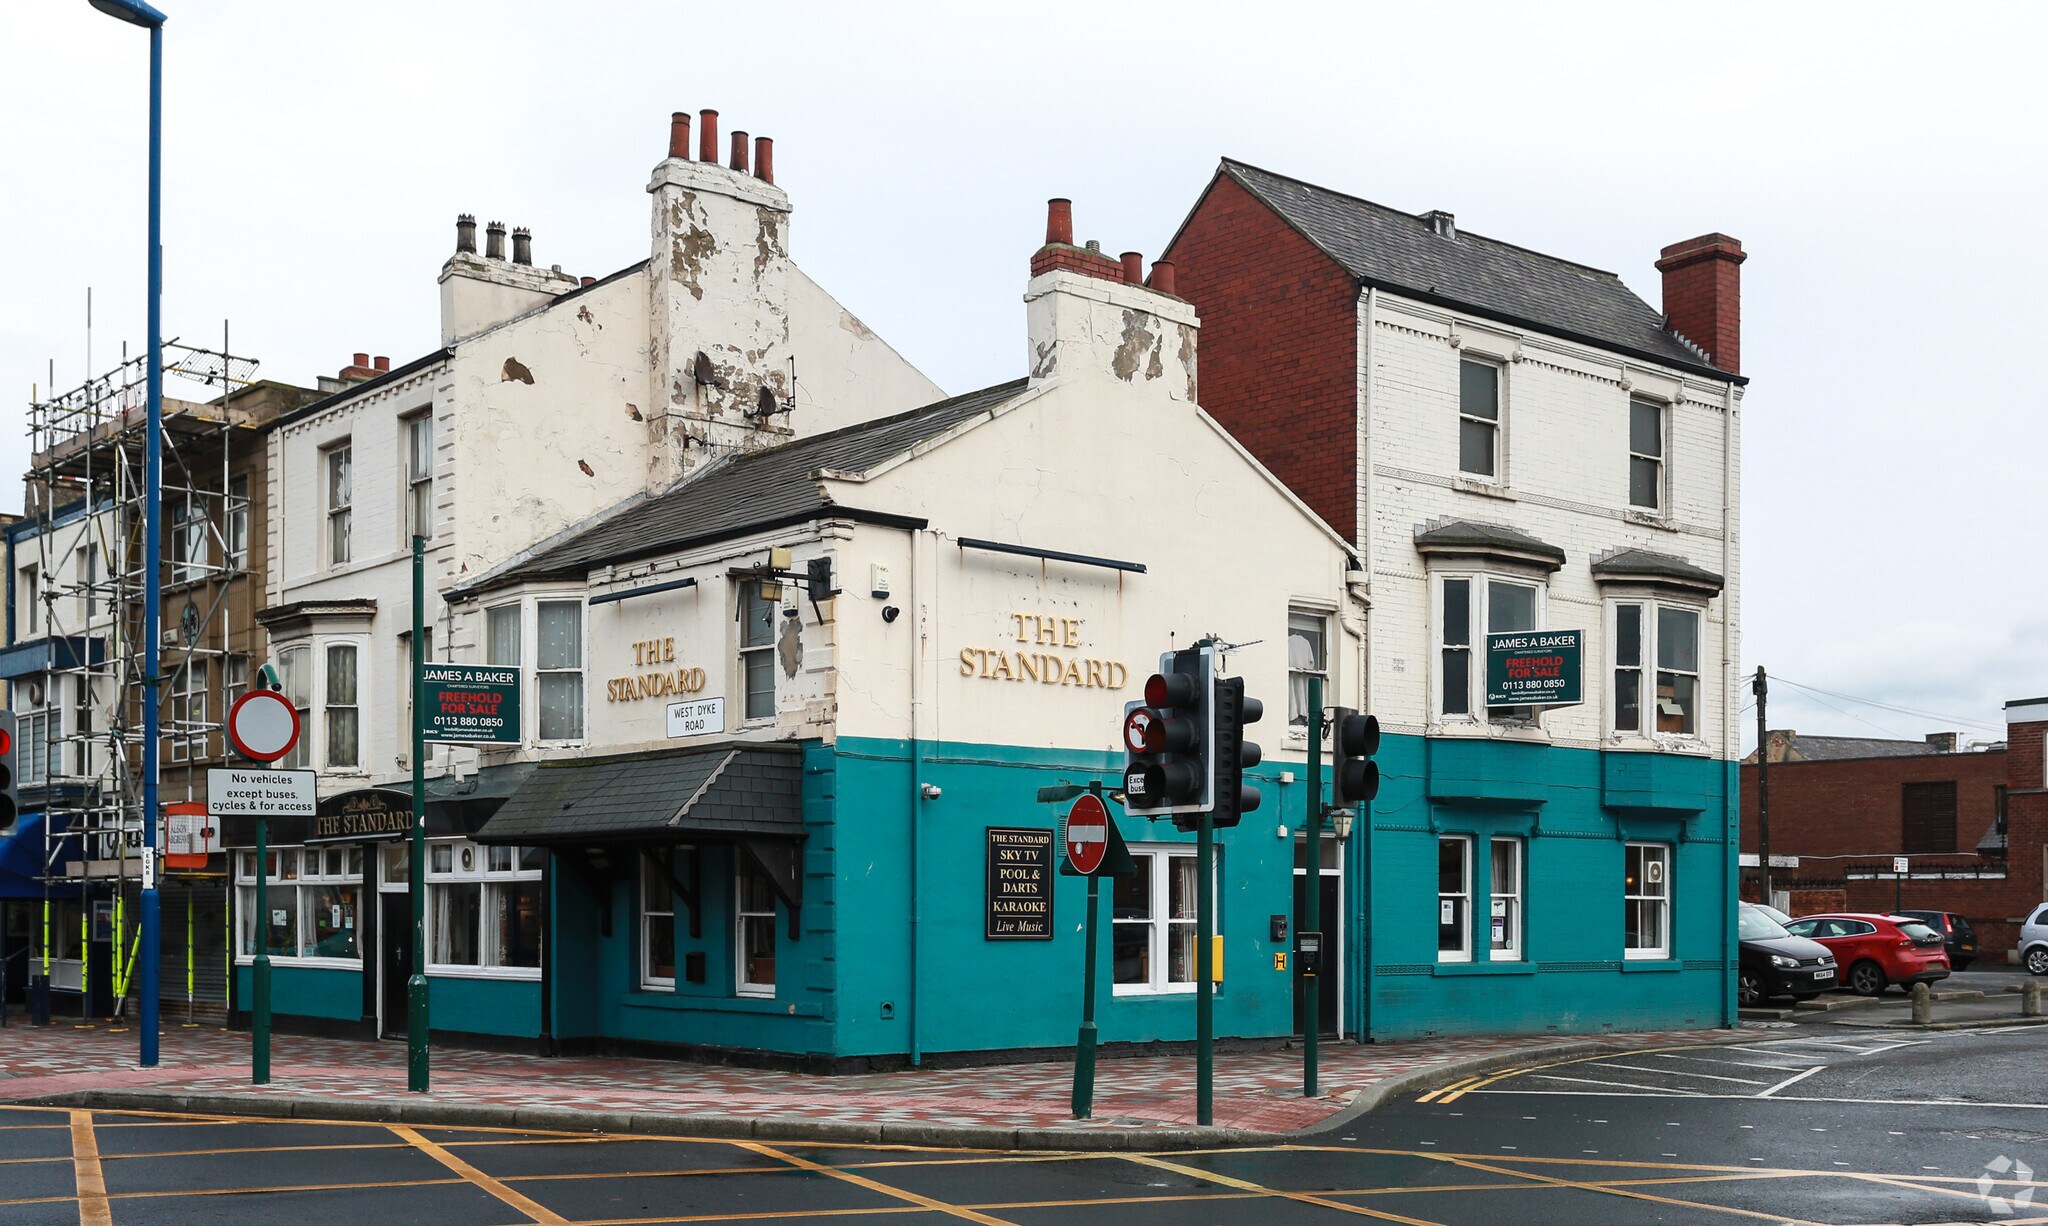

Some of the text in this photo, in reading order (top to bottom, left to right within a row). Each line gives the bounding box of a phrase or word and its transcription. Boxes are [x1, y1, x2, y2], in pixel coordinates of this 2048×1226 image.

[1011, 612, 1081, 648] THE
[1492, 635, 1575, 649] JAMES A BAKER
[632, 637, 675, 665] THE
[1505, 656, 1563, 667] FREEHOLD
[960, 647, 1129, 689] STANDARD
[1508, 666, 1560, 678] FOR SALE
[423, 670, 514, 683] JAMES A BAKER
[607, 667, 706, 703] STANDARD
[1502, 679, 1565, 690] 0113 880 0850
[438, 691, 503, 703] FREEHOLD
[441, 703, 498, 715] FOR SALE
[674, 703, 716, 719] WEST DYKE
[434, 716, 504, 727] 0113 880 0850
[685, 719, 705, 731] ROAD
[231, 773, 293, 785] No vehicles
[226, 789, 263, 800] except
[212, 801, 246, 812] cycles
[249, 802, 257, 810] &
[260, 801, 275, 811] for
[317, 810, 414, 836] THE STANDARD
[991, 834, 1050, 844] THE STANDARD
[1000, 849, 1040, 861] SKY TV
[1000, 868, 1041, 880] POOL &
[1002, 882, 1038, 893] DARTS
[993, 901, 1047, 912] KARAOKE
[996, 920, 1044, 932] Live Music
